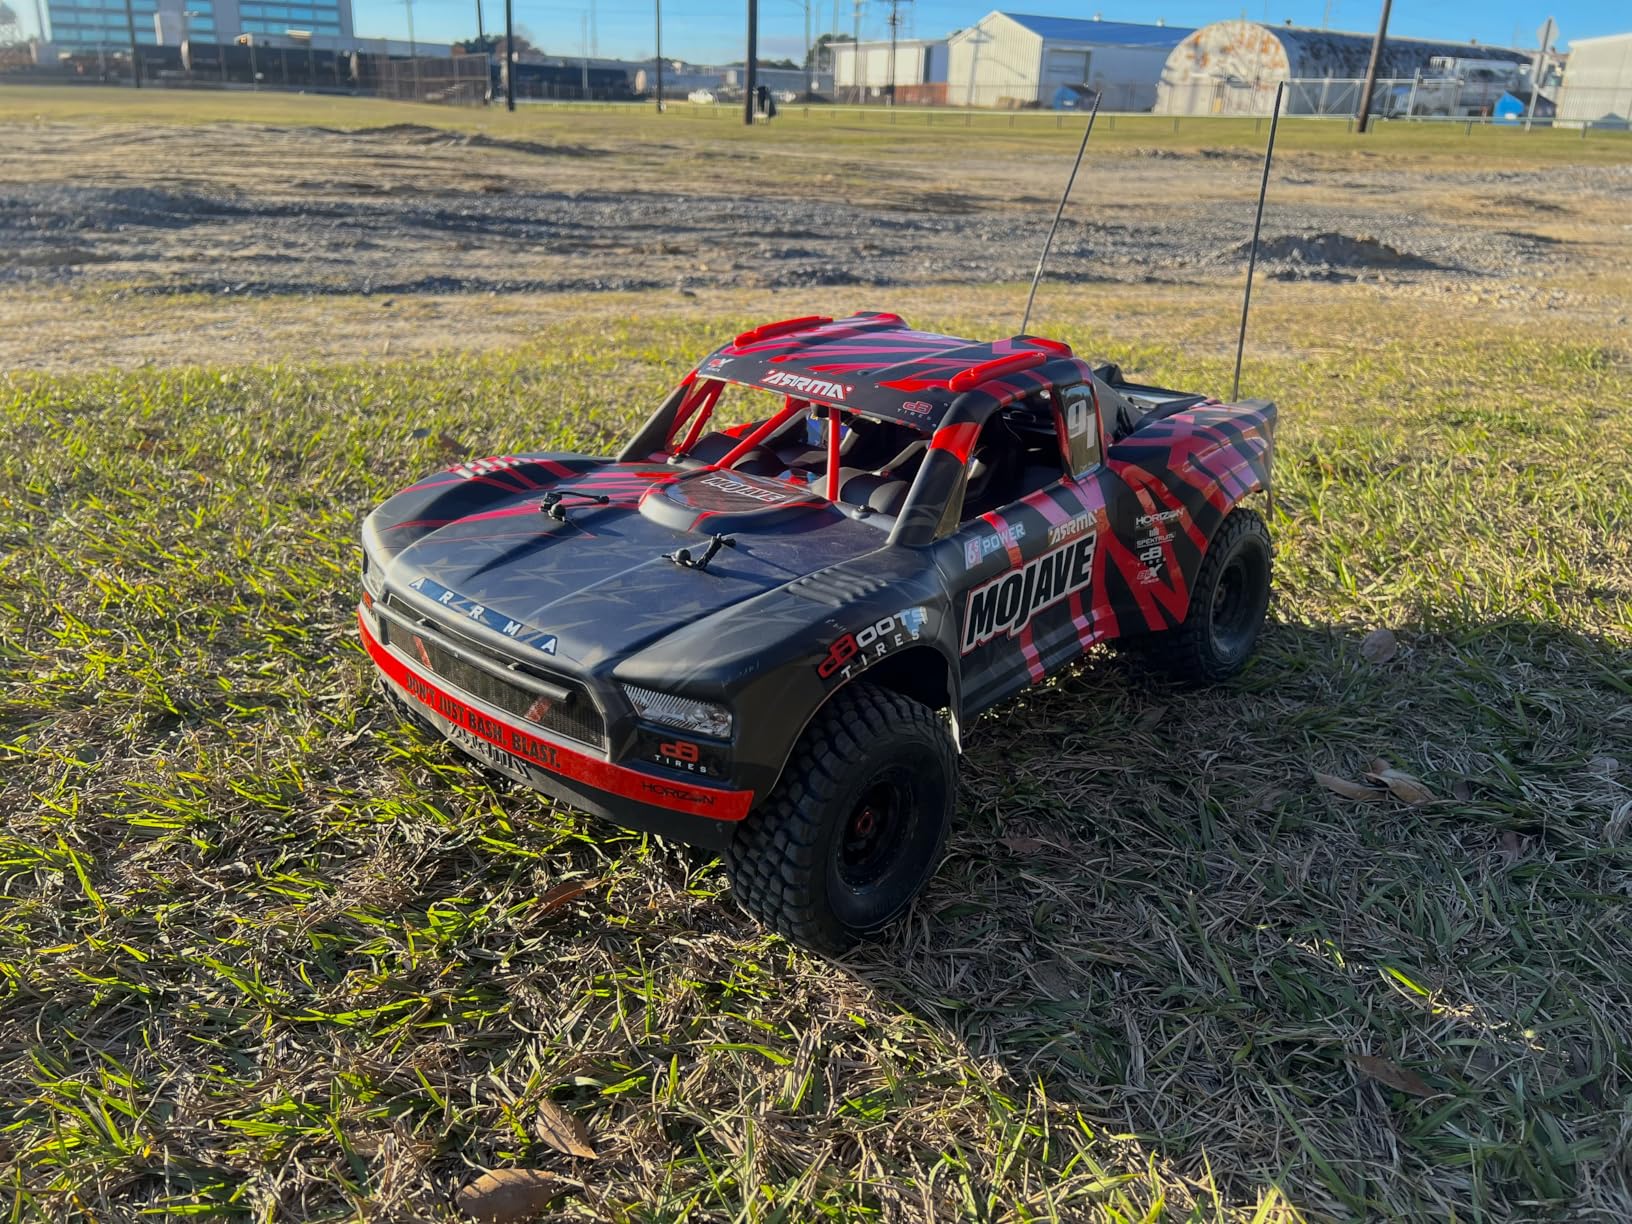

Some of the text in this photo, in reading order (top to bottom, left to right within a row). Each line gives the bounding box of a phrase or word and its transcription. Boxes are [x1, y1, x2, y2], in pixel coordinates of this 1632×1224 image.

[1067, 399, 1096, 449] 91
[700, 476, 786, 502] MOJAVE
[982, 521, 1026, 553] POWER
[410, 577, 558, 656] ARRMA
[963, 531, 1096, 653] MOJAVE
[841, 629, 920, 679] TIRES
[406, 672, 437, 708] DON'T
[439, 696, 465, 724] JUST
[468, 708, 507, 746] BASH.
[512, 731, 561, 768] BLAST.
[654, 754, 707, 773] TIRES
